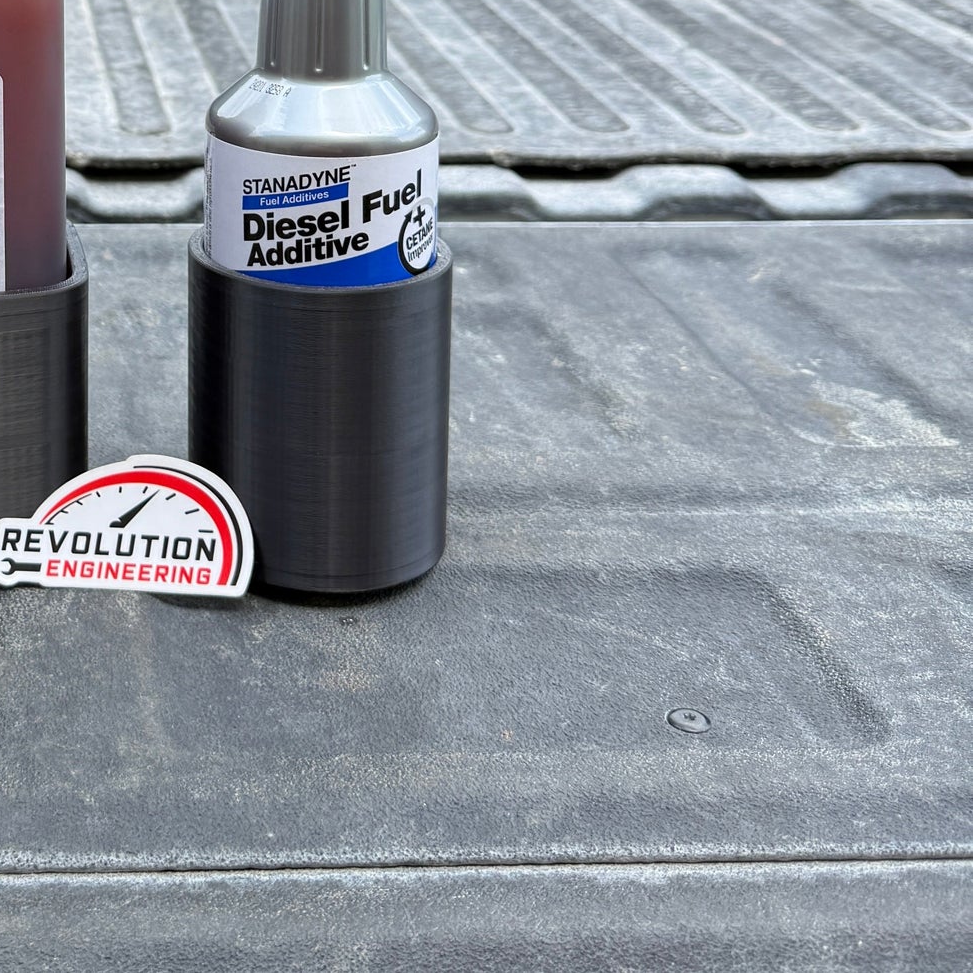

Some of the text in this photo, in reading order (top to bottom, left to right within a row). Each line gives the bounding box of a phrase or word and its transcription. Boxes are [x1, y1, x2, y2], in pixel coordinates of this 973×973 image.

[243, 199, 350, 242] Diesel
[362, 168, 422, 224] Fuel
[260, 190, 330, 207] Fuel Additives
[247, 231, 370, 267] Additive
[406, 216, 434, 250] CETANE
[1, 528, 216, 561] REVOLUTION
[46, 559, 212, 585] ENGINEERING
